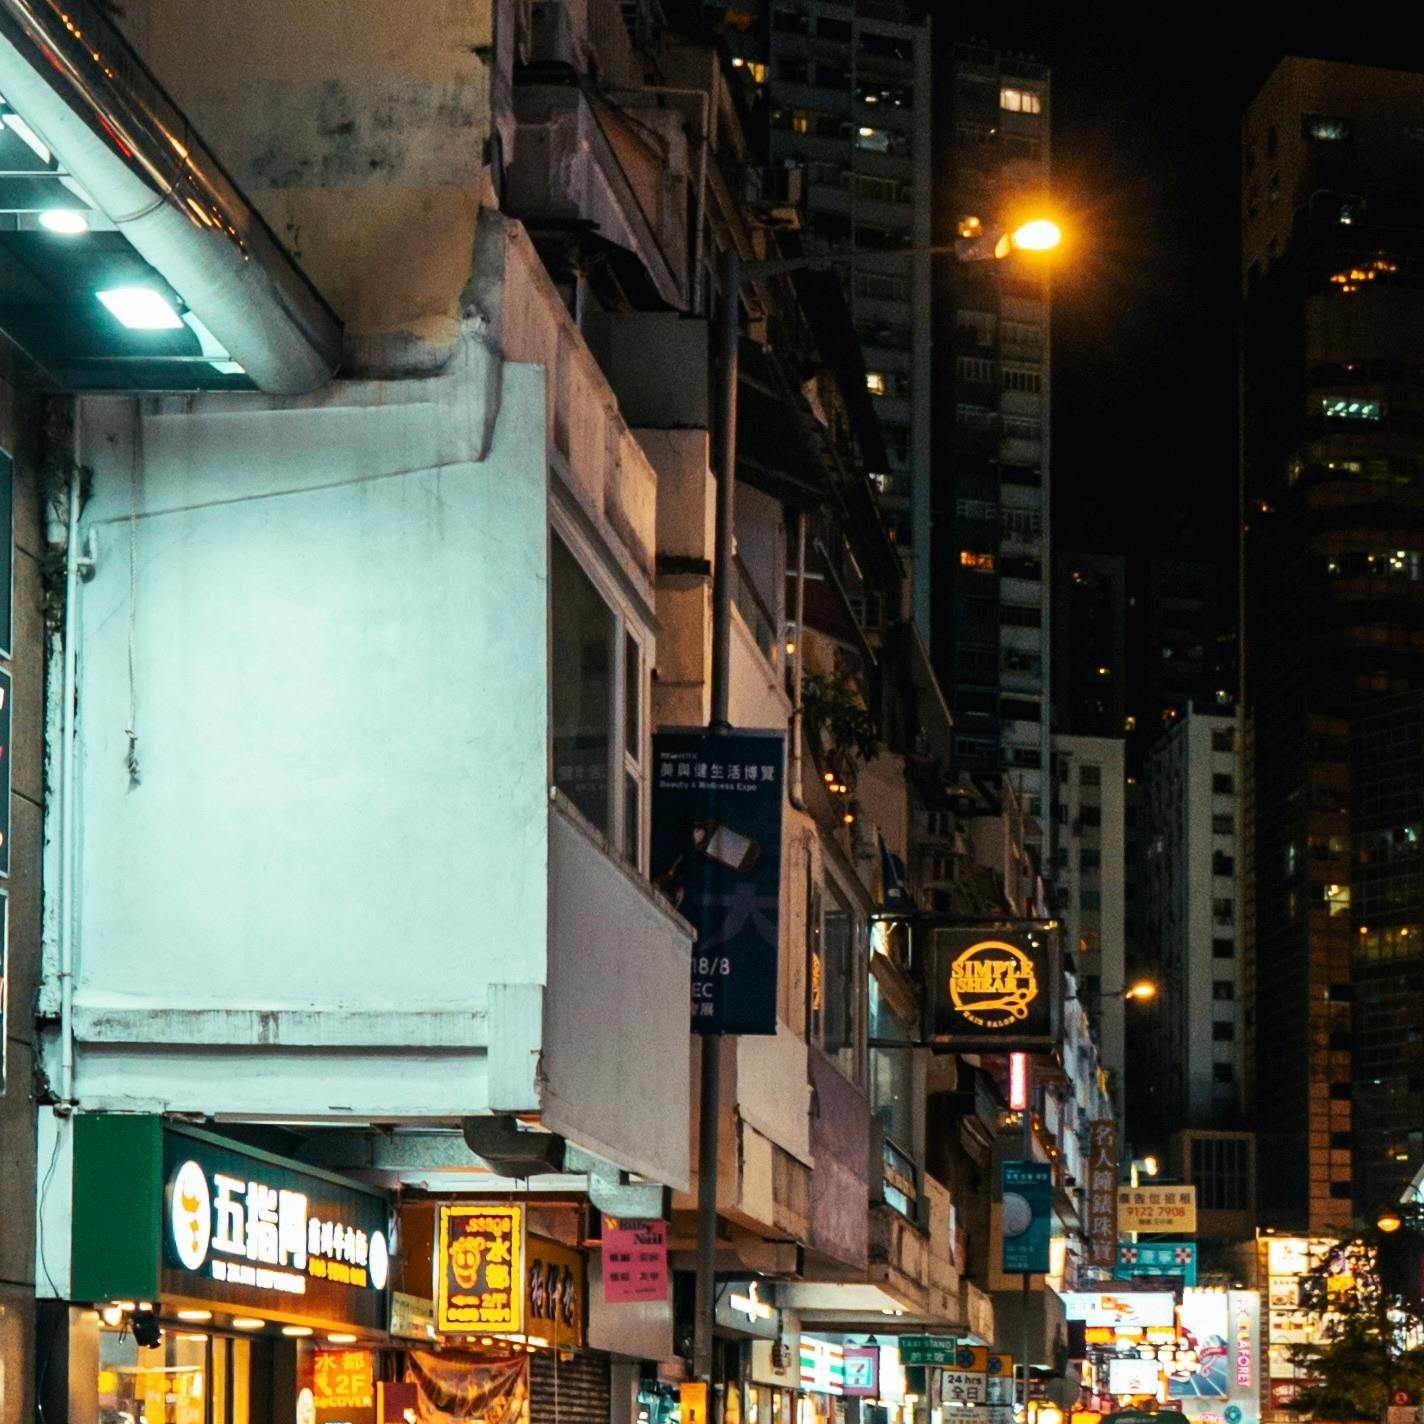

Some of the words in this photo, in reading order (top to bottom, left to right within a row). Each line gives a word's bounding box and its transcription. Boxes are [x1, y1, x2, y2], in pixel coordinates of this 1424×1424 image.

[952, 960, 1034, 978] SIMPLE
[957, 977, 1018, 993] SHEAR
[1158, 1206, 1186, 1217] 7908
[902, 1340, 921, 1349] TAXI
[923, 1340, 953, 1350] STAND
[336, 1375, 365, 1394] 2F
[948, 1374, 963, 1384] 24
[965, 1374, 982, 1384] hrs
[951, 1387, 979, 1401] 全日
